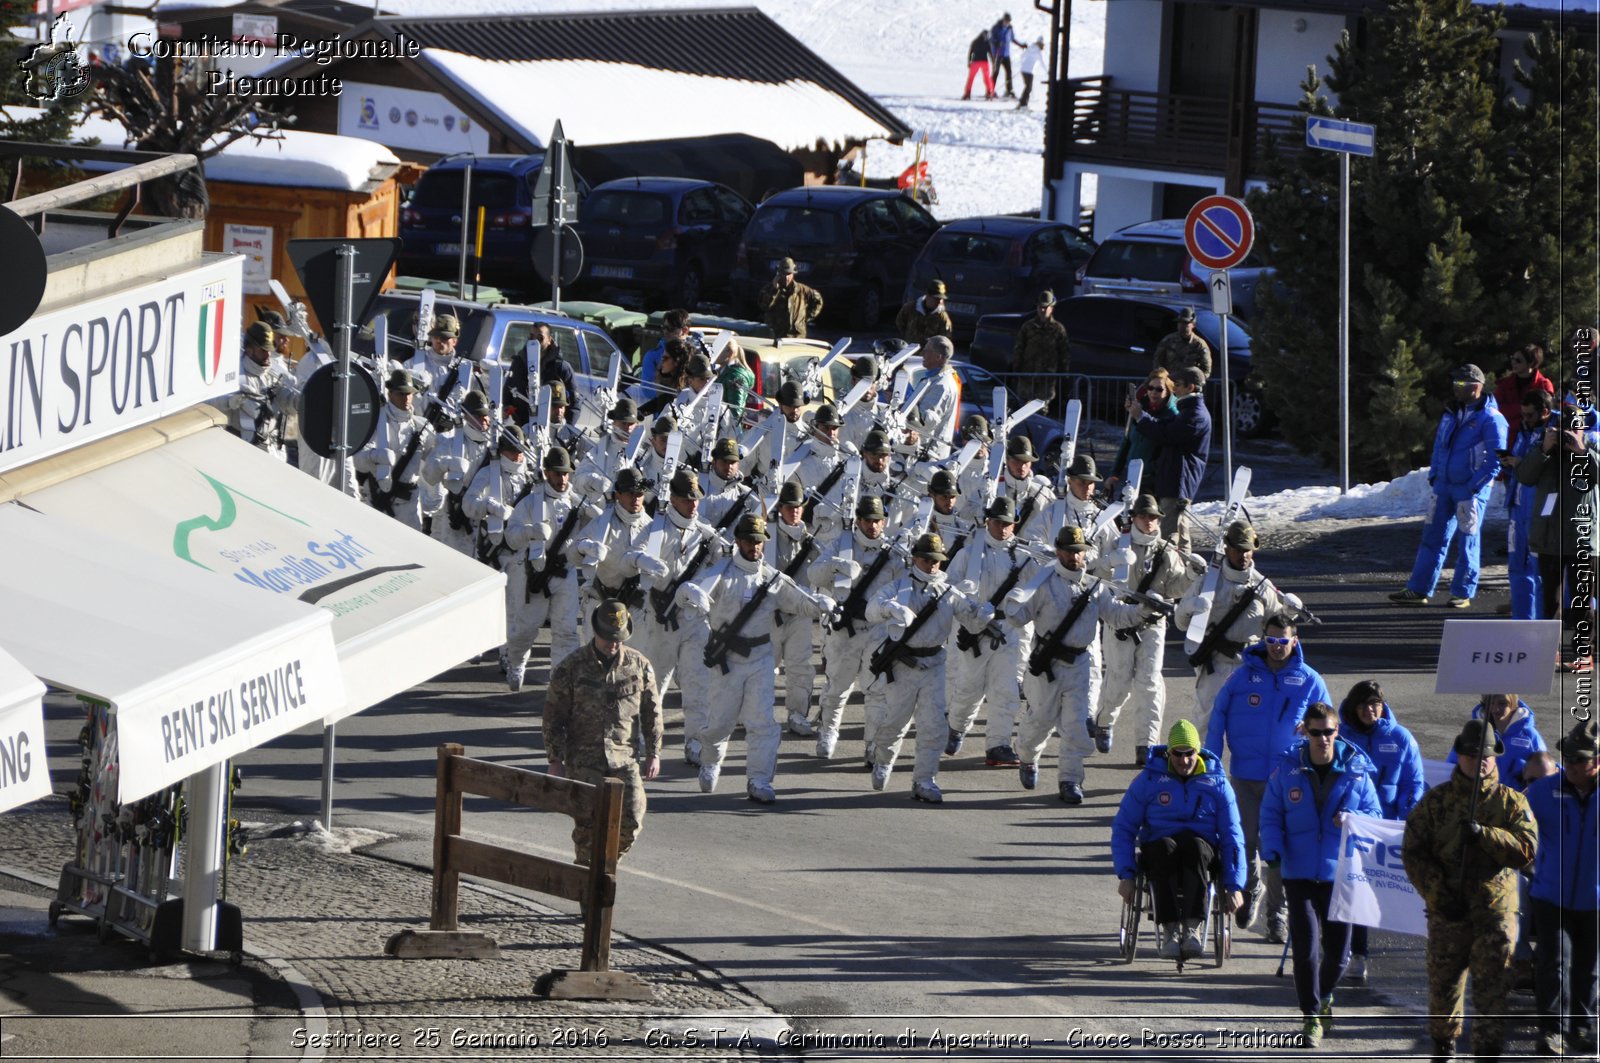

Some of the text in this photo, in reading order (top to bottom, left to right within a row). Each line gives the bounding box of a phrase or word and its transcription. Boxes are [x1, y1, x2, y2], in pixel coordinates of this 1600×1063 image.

[201, 282, 225, 303] ITALIA
[0, 291, 185, 453] IN SPORT
[307, 528, 375, 570] Sport
[1471, 651, 1528, 664] FISIP
[161, 659, 307, 763] RENT SKI SERVICE
[0, 730, 31, 789] NG
